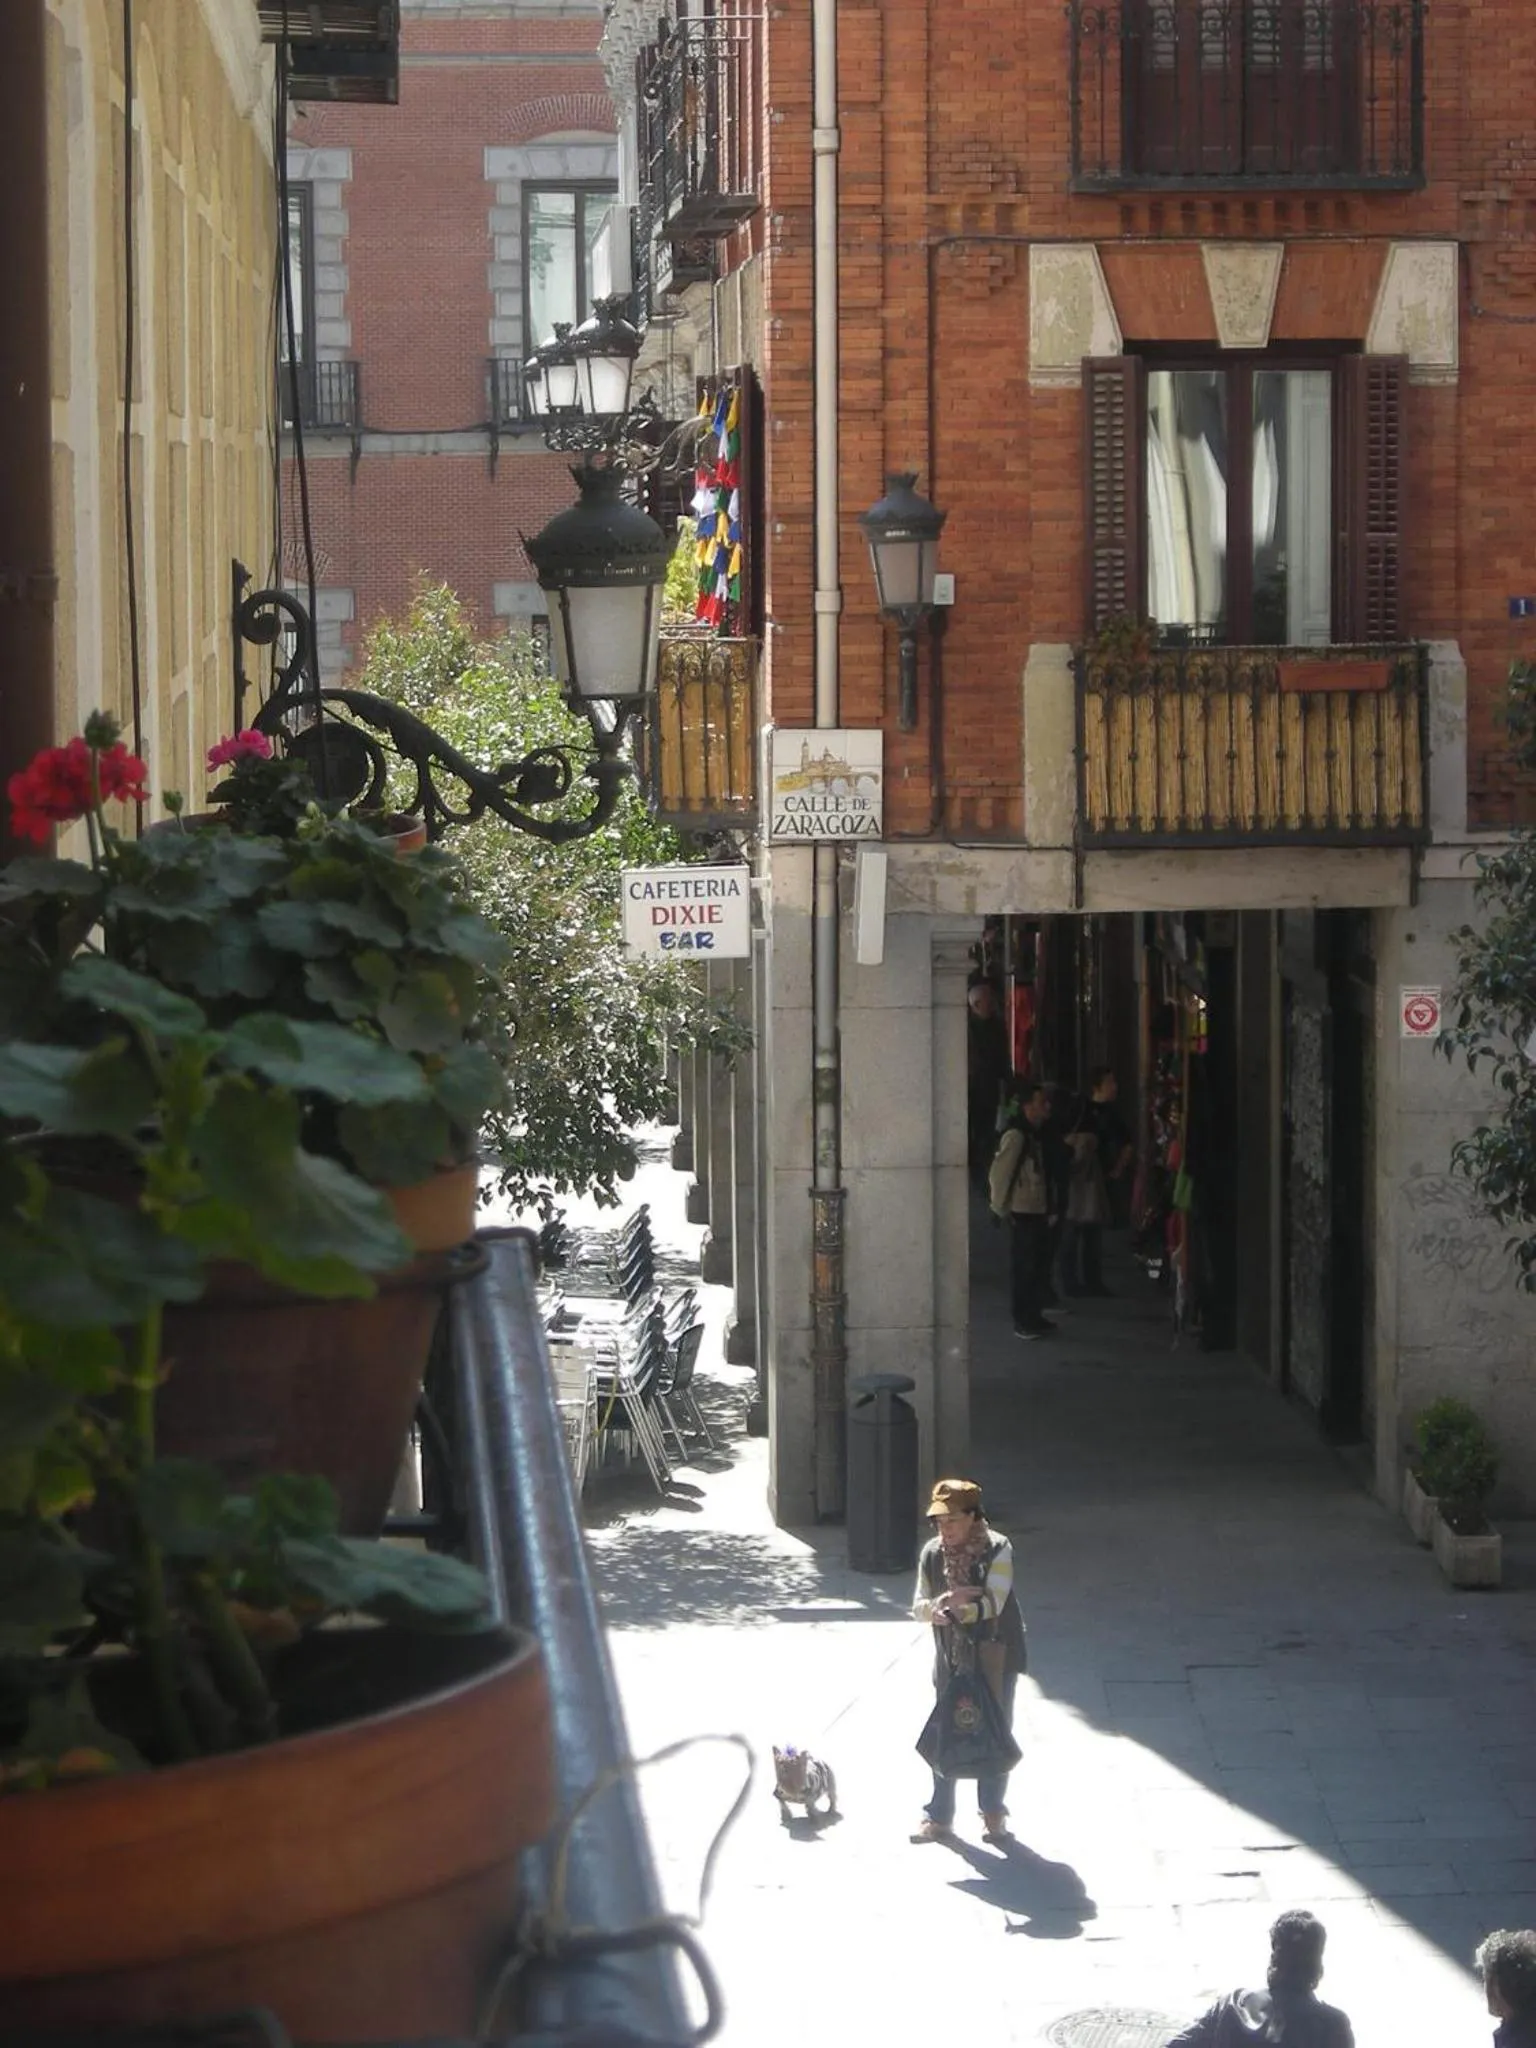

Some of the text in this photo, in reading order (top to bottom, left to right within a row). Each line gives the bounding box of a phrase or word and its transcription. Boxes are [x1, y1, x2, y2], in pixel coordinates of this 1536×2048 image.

[784, 797, 871, 812] CALLE DE
[773, 814, 880, 834] ZARAGOZA
[629, 878, 740, 900] CAFETERIA
[652, 904, 723, 926] DIXIE
[660, 931, 715, 950] BAR
